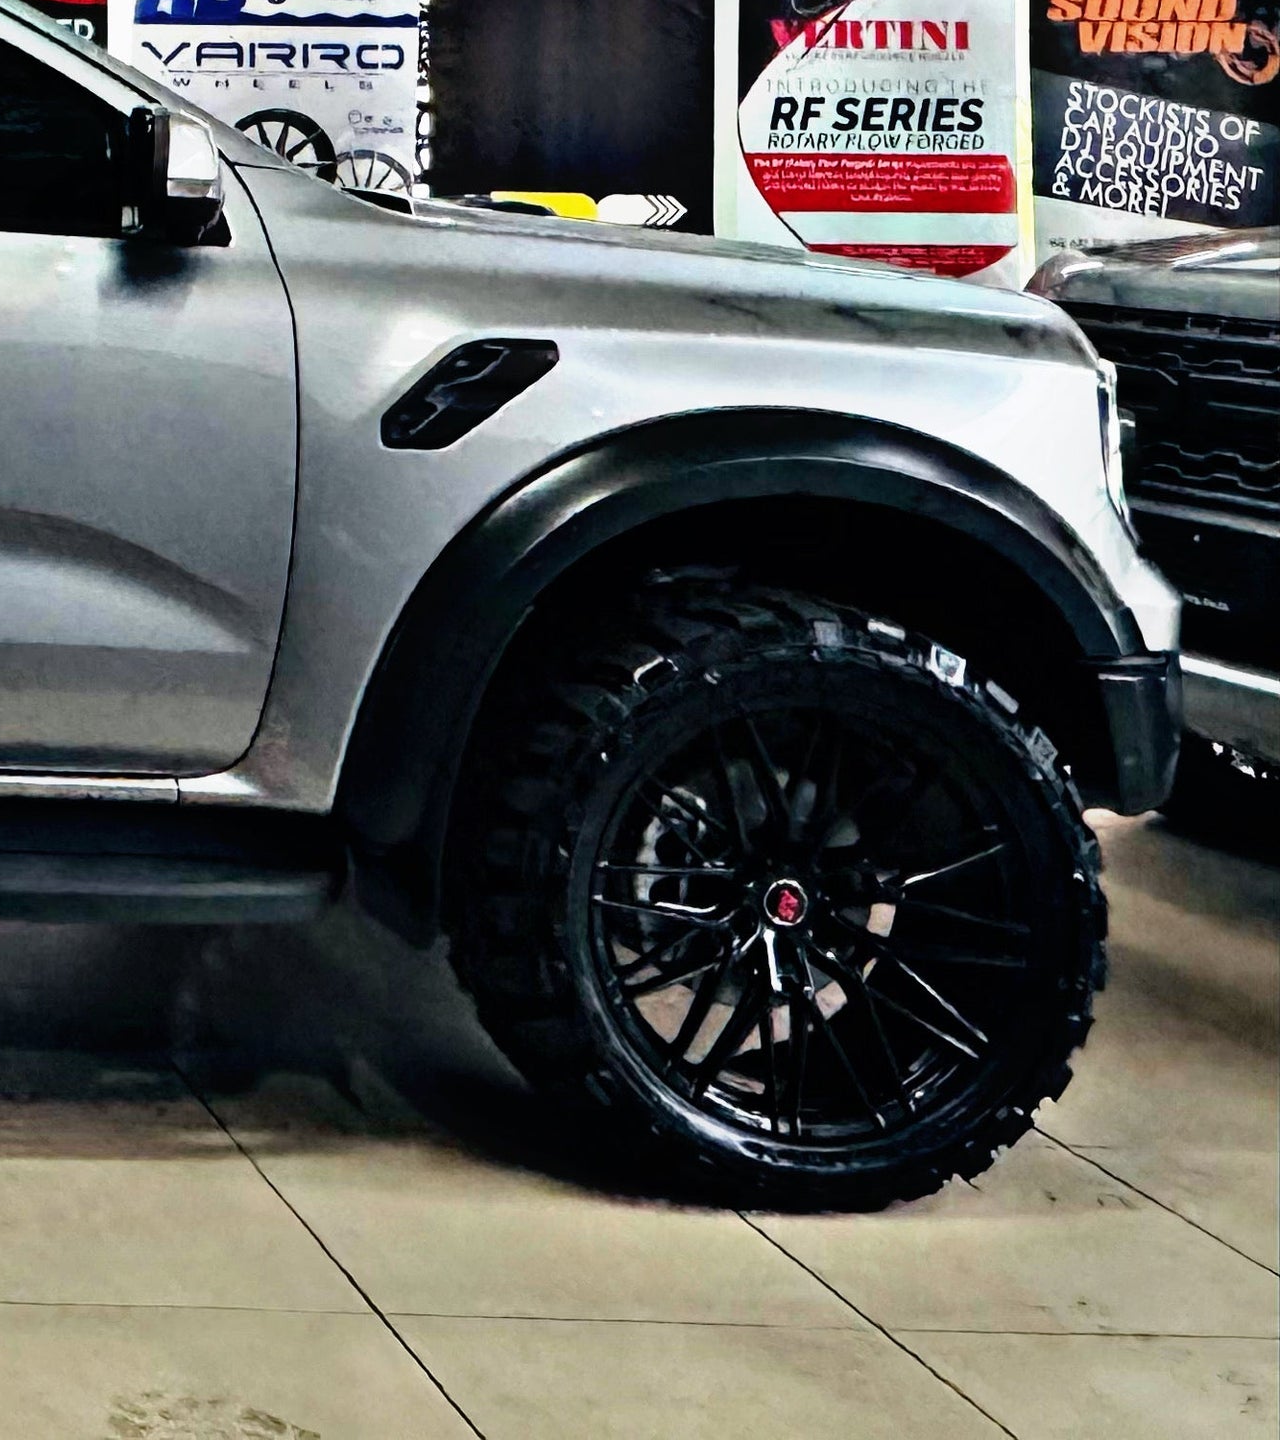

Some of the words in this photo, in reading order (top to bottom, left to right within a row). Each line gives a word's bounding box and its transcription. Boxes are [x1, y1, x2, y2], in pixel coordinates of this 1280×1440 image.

[769, 20, 970, 50] VERTINI
[1078, 21, 1246, 54] VISION
[770, 96, 826, 131] RF
[832, 97, 985, 132] SERIES
[1064, 106, 1116, 140] CAR
[1124, 121, 1219, 158] AUDIO
[1067, 81, 1211, 136] STOCKISTS
[1219, 114, 1261, 145] OF
[768, 132, 840, 151] ROTARY
[906, 133, 985, 152] FORGED
[1100, 137, 1264, 191] EQUIPMENT
[1055, 150, 1240, 210] ACCESSORIES
